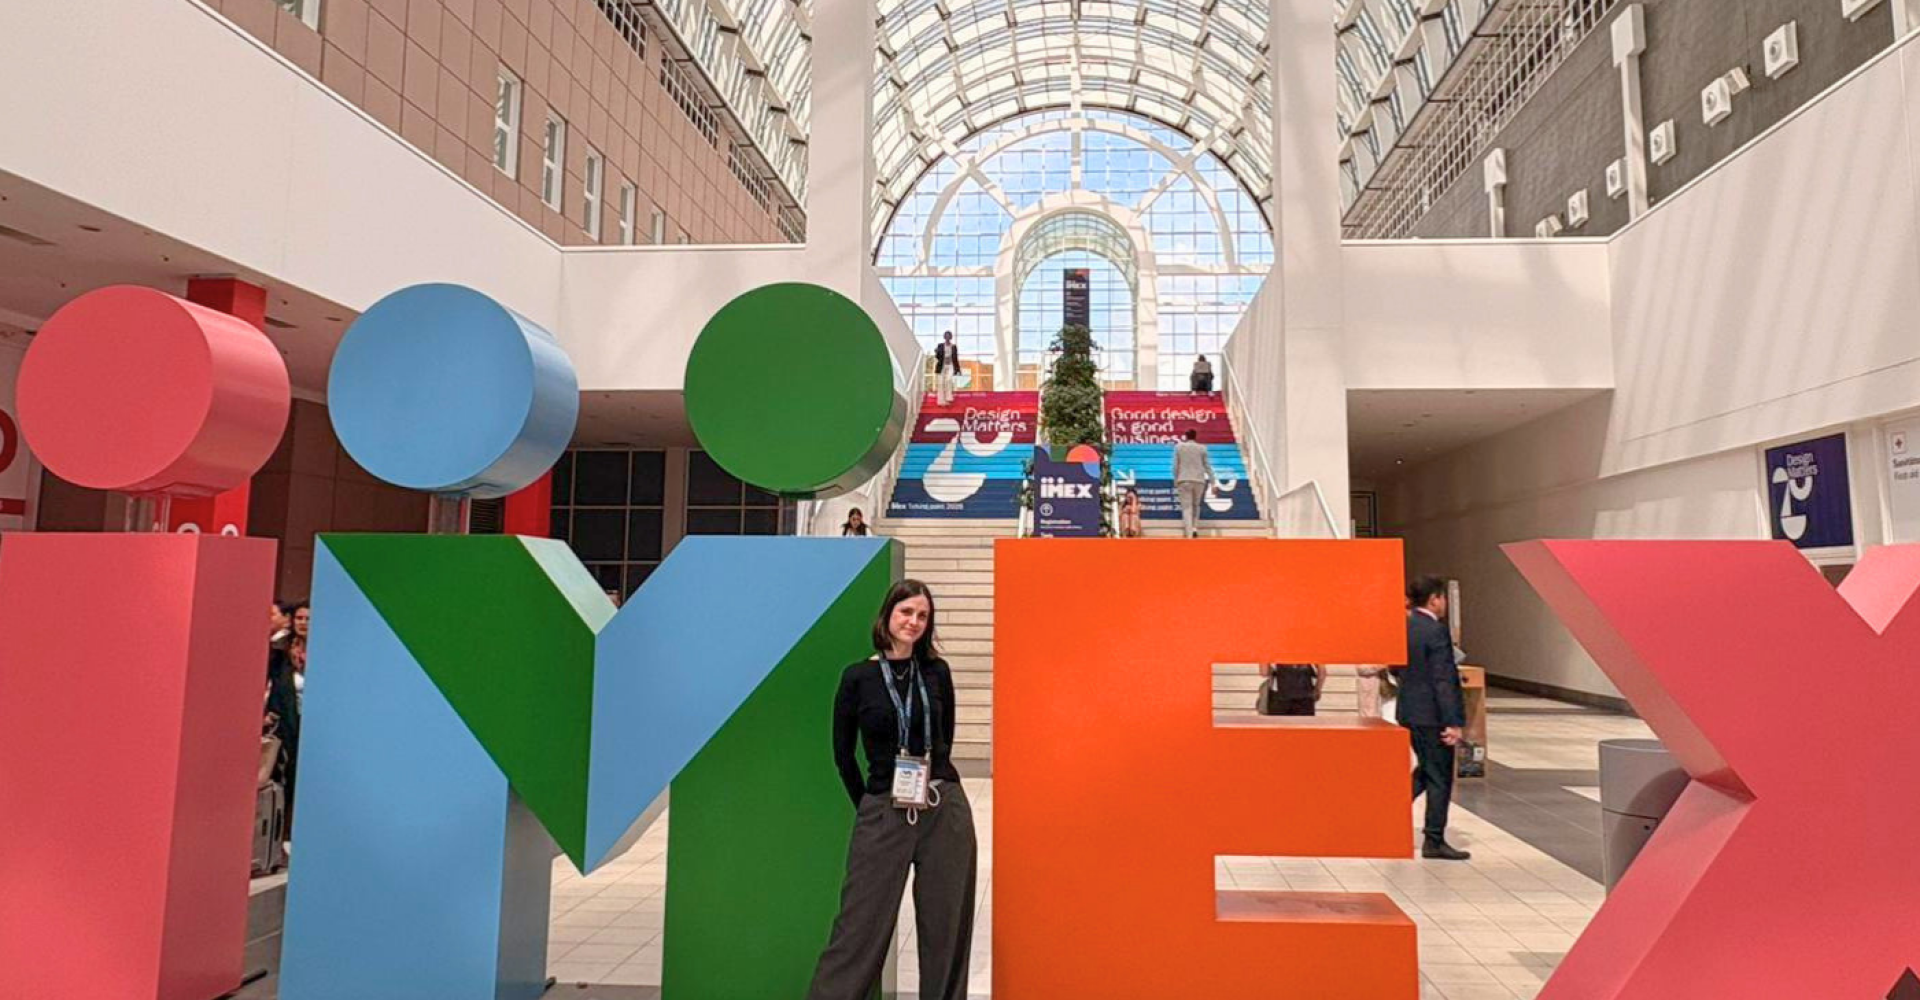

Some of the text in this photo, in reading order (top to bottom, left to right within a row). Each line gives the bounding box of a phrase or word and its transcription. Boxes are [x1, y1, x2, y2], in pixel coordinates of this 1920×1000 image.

[966, 407, 1020, 421] Design
[1111, 407, 1216, 423] Good design
[962, 418, 1027, 432] Matters
[1111, 419, 1174, 435] is good
[1786, 453, 1814, 466] Design
[1787, 465, 1818, 477] Matters
